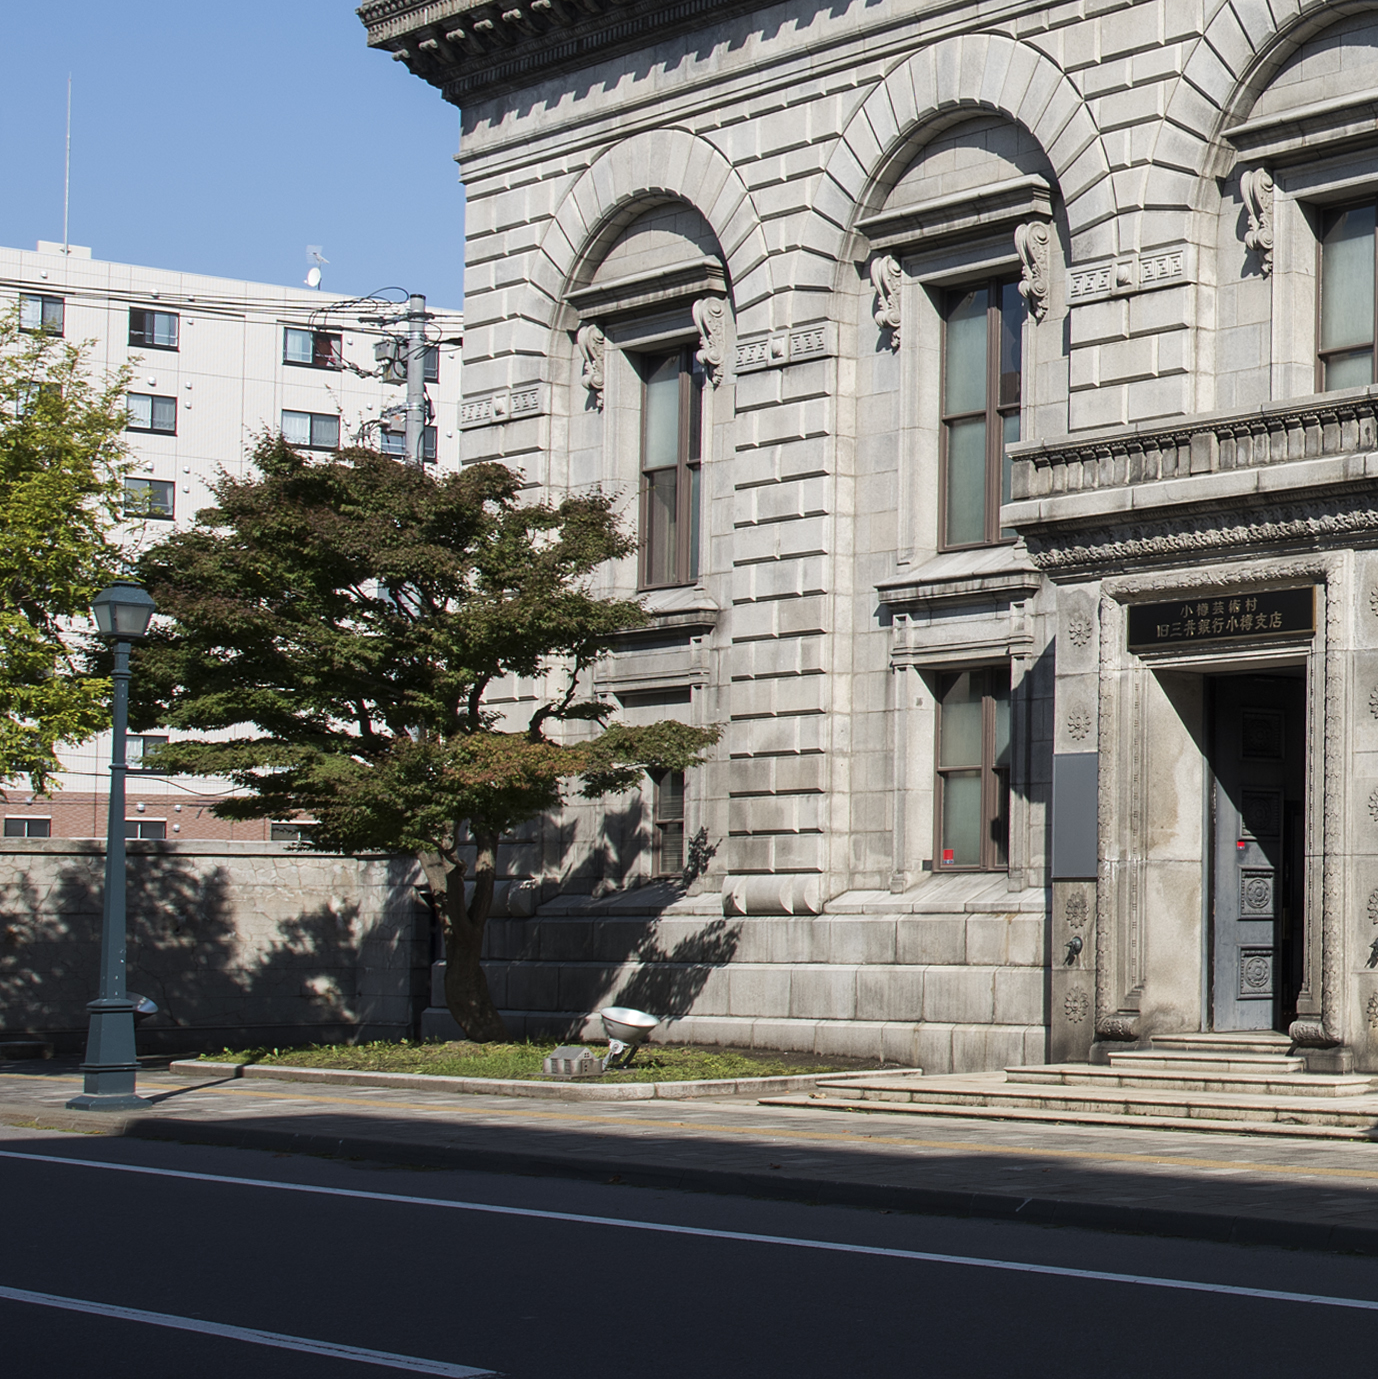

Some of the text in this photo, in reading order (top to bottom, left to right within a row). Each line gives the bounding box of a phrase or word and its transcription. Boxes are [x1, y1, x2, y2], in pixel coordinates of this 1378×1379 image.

[1180, 597, 1258, 619] 小樽芸術村
[1156, 611, 1283, 638] 旧三井銀行小樽支店
